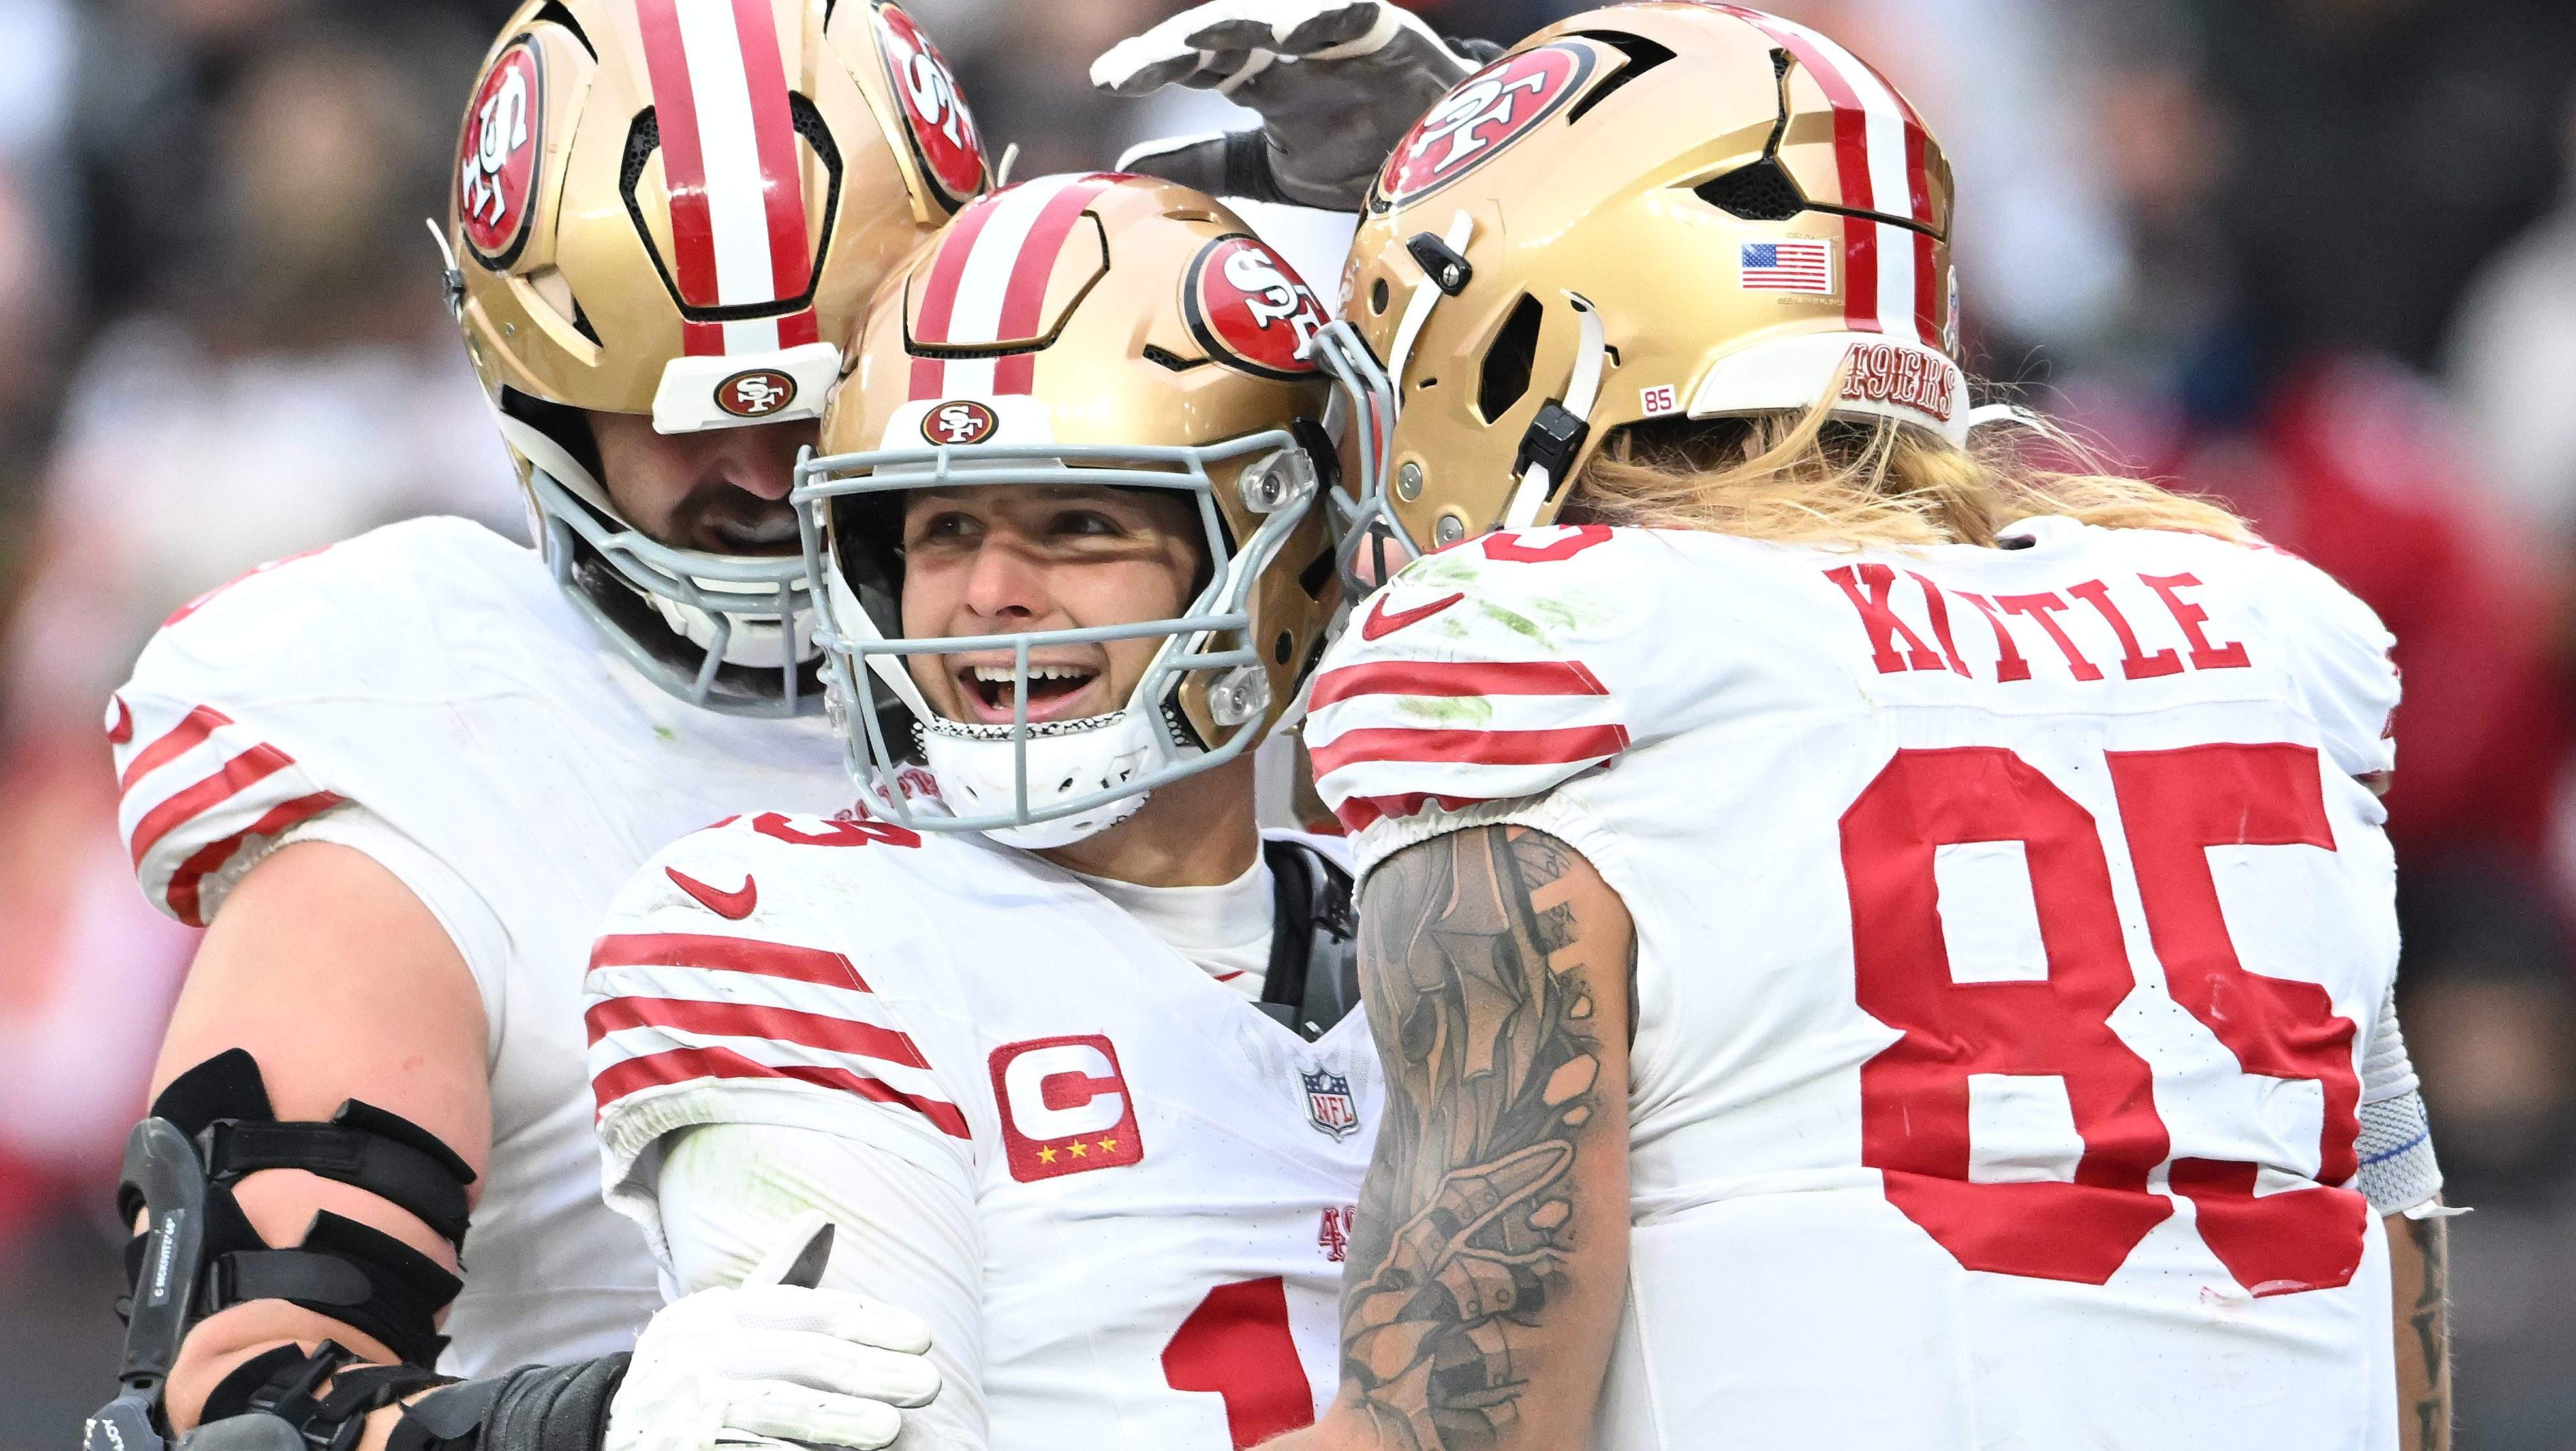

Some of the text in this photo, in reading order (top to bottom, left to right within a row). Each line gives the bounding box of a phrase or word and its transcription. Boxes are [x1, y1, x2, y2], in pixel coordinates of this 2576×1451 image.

[463, 67, 527, 227] SF
[1408, 63, 1547, 173] SF
[736, 376, 783, 412] SF
[939, 405, 983, 443] SF
[1645, 388, 1671, 413] 85
[1840, 343, 1955, 423] 49ERS
[1822, 563, 2251, 683] KITTLE
[1838, 742, 2367, 1298] 85
[1005, 1044, 1125, 1141] C
[1312, 1095, 1354, 1126] NFL
